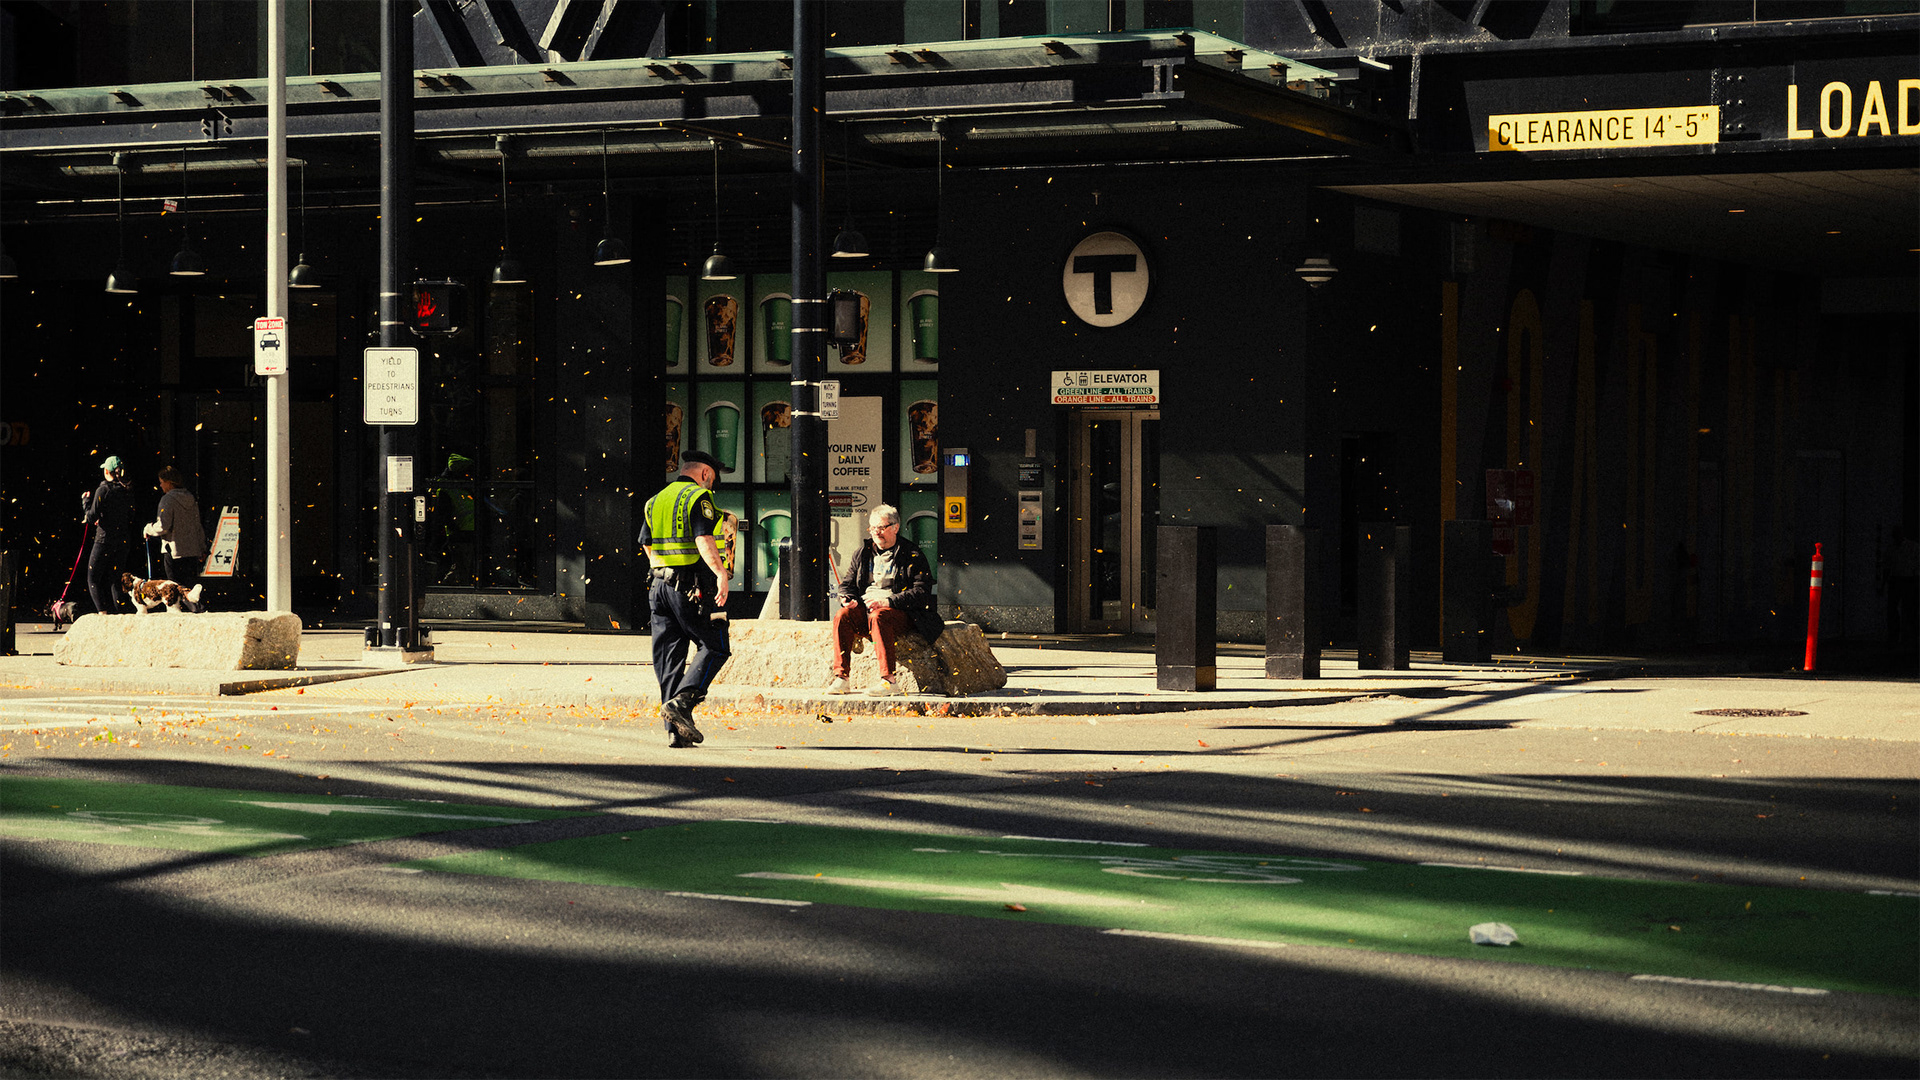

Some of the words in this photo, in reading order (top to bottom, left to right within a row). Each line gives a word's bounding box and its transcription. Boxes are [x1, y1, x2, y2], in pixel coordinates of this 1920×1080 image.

[1787, 79, 1920, 139] LOAD
[1498, 117, 1634, 146] CLEARANCE
[1073, 254, 1137, 315] T
[257, 321, 267, 329] TOW
[268, 320, 283, 329] ZONE
[381, 358, 402, 366] YIELD
[1093, 374, 1147, 383] ELEVATOR
[368, 383, 415, 391] PEDESTRIANS
[386, 395, 396, 403] ON
[828, 444, 853, 453] YOUR
[854, 444, 876, 453] NEW
[838, 456, 865, 464] DAILY
[833, 467, 870, 476] COFFEE
[677, 489, 692, 529] POLICE
